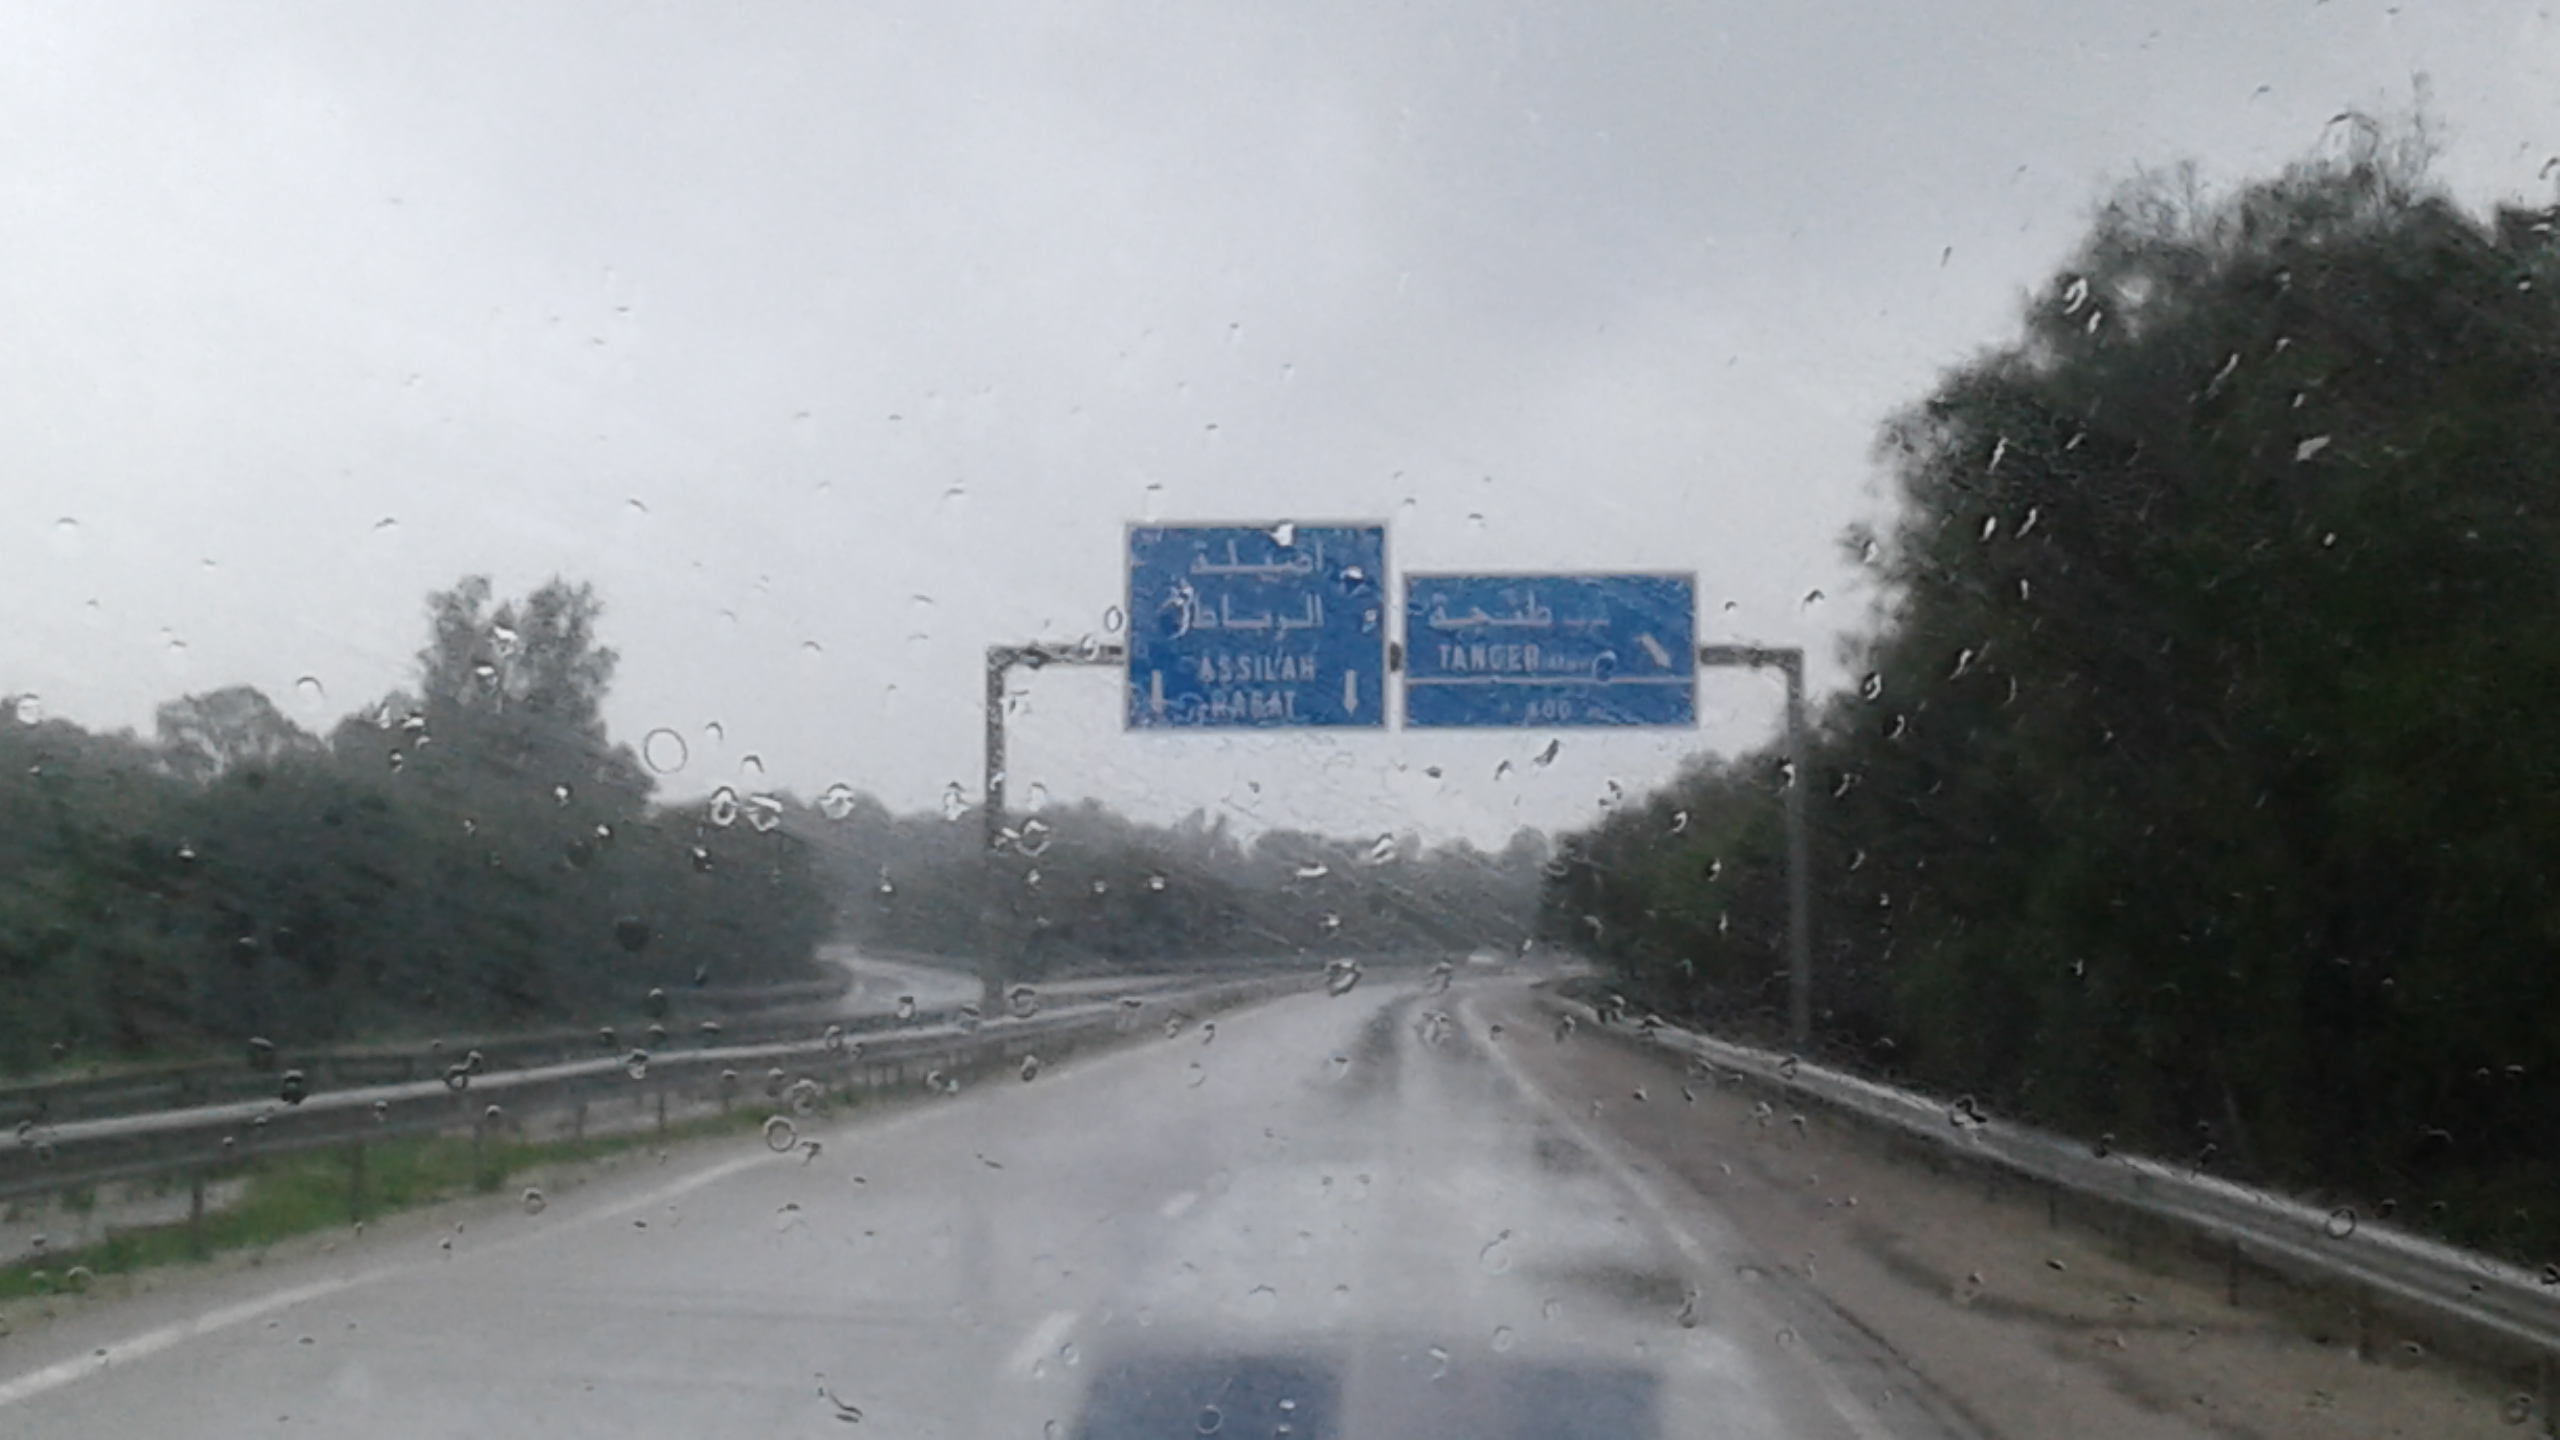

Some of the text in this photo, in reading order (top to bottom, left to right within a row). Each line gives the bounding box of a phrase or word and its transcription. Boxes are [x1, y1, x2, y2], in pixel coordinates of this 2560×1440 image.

[1198, 655, 1317, 682] ASSILAH
[1437, 644, 1541, 672] TANGER
[1211, 690, 1297, 719] RABAT
